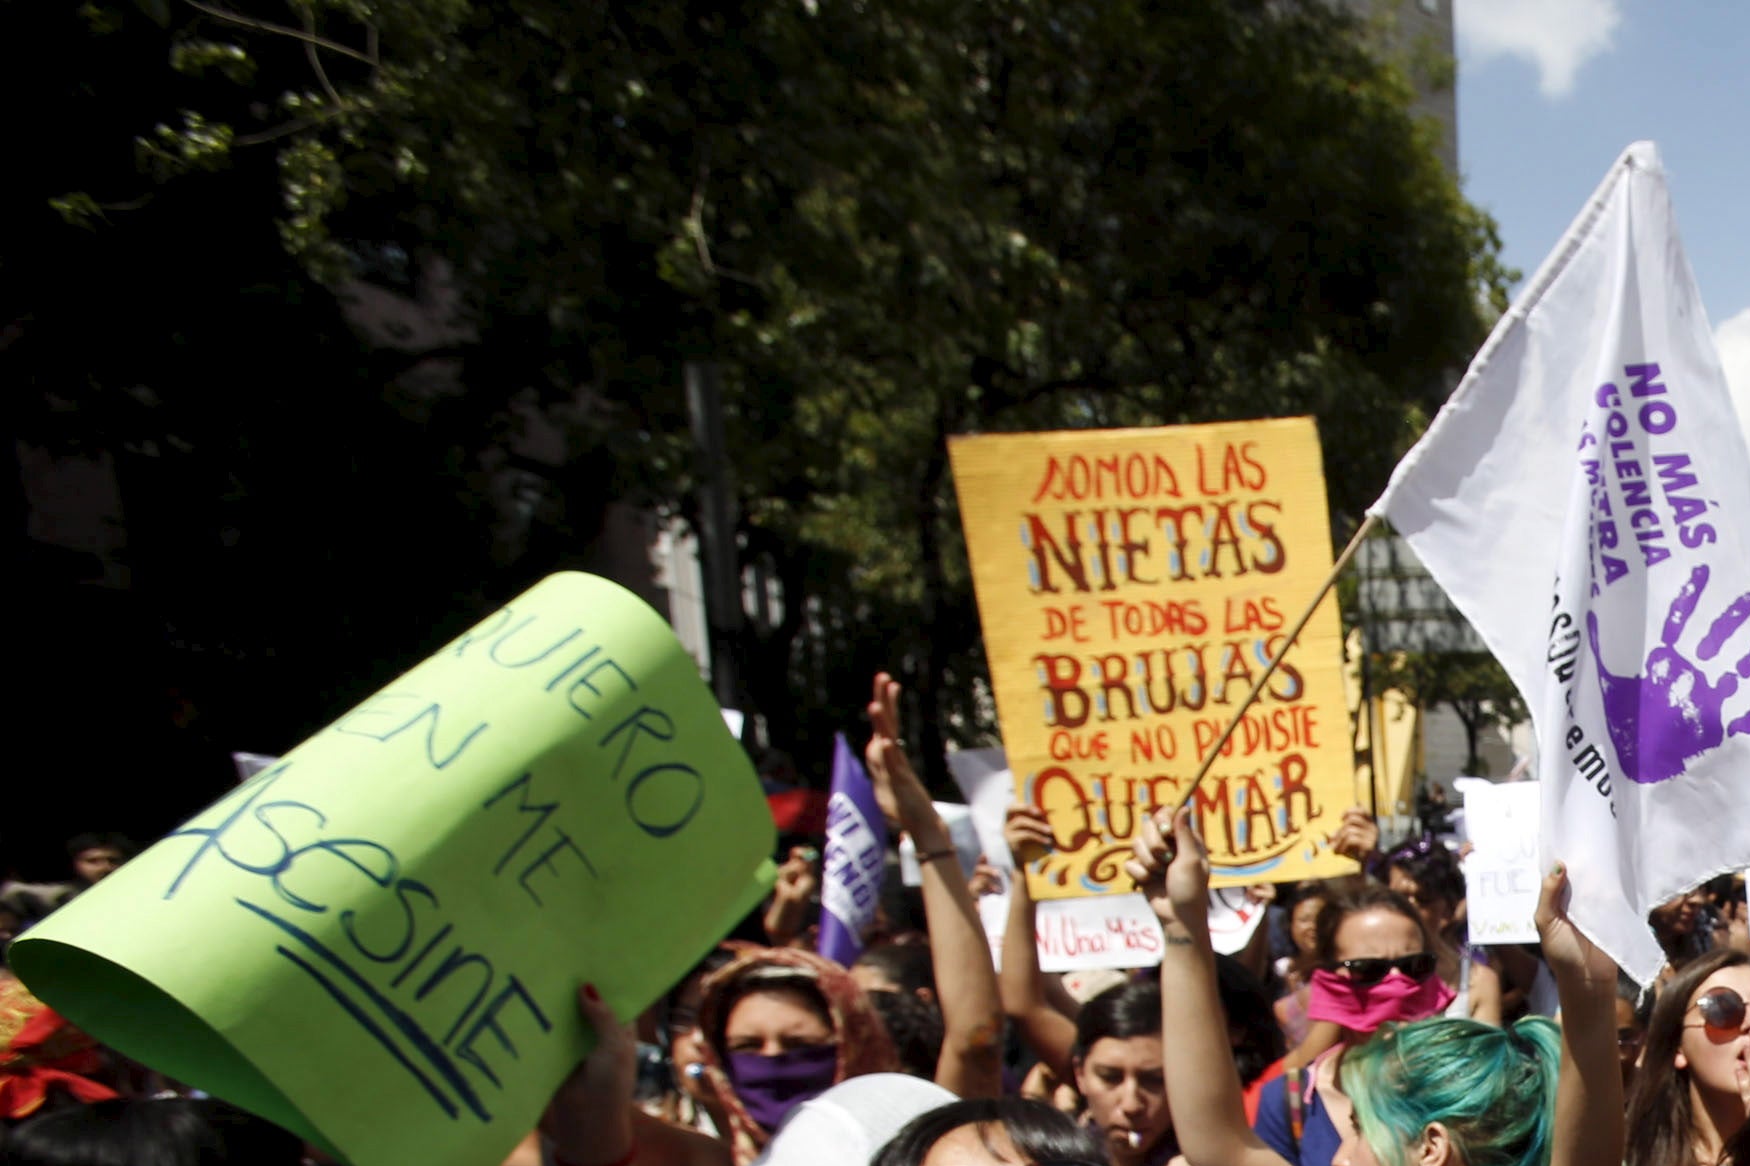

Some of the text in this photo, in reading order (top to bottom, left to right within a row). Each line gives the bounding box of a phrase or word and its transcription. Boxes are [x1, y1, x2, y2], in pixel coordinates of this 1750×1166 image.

[1034, 440, 1268, 504] SOMOS LAS
[1606, 396, 1672, 568] OLENCIA
[1624, 363, 1720, 549] NO MÁS
[1023, 500, 1288, 595] NIETAS
[1040, 596, 1285, 642] DE TODAS LAS
[1032, 634, 1305, 729] BRUJAS
[1049, 705, 1322, 764] QUE NO PUDISTE
[483, 771, 599, 909] ME
[1033, 753, 1323, 858] QUEMAR
